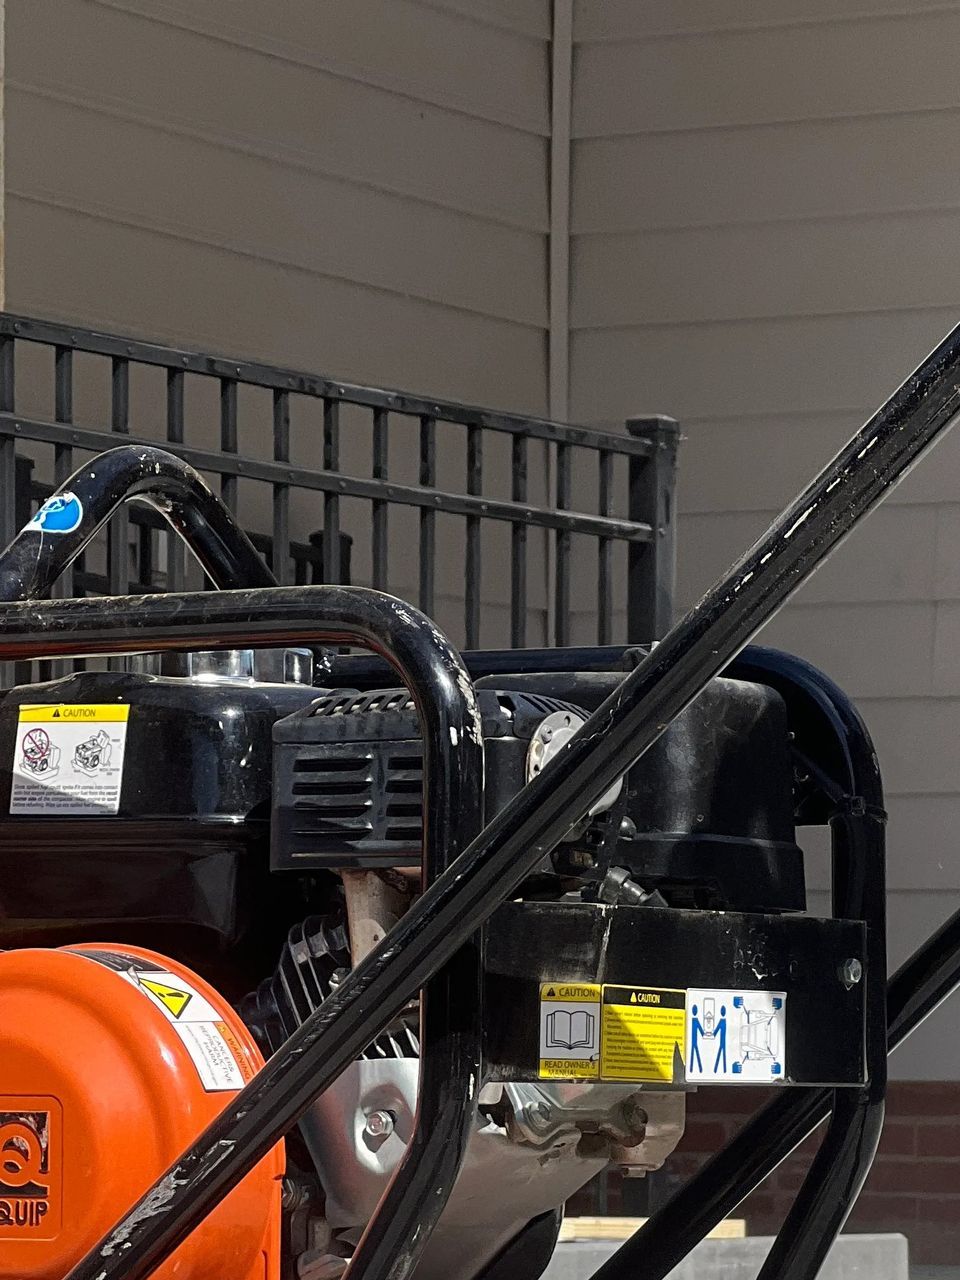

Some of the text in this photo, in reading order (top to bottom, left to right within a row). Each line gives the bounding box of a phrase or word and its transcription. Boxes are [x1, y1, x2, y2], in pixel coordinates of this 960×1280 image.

[63, 709, 96, 717] CAUTION
[559, 987, 595, 997] CAUTION
[638, 993, 660, 1003] CAUTION
[228, 1038, 251, 1080] WARNING
[545, 1061, 562, 1069] READ
